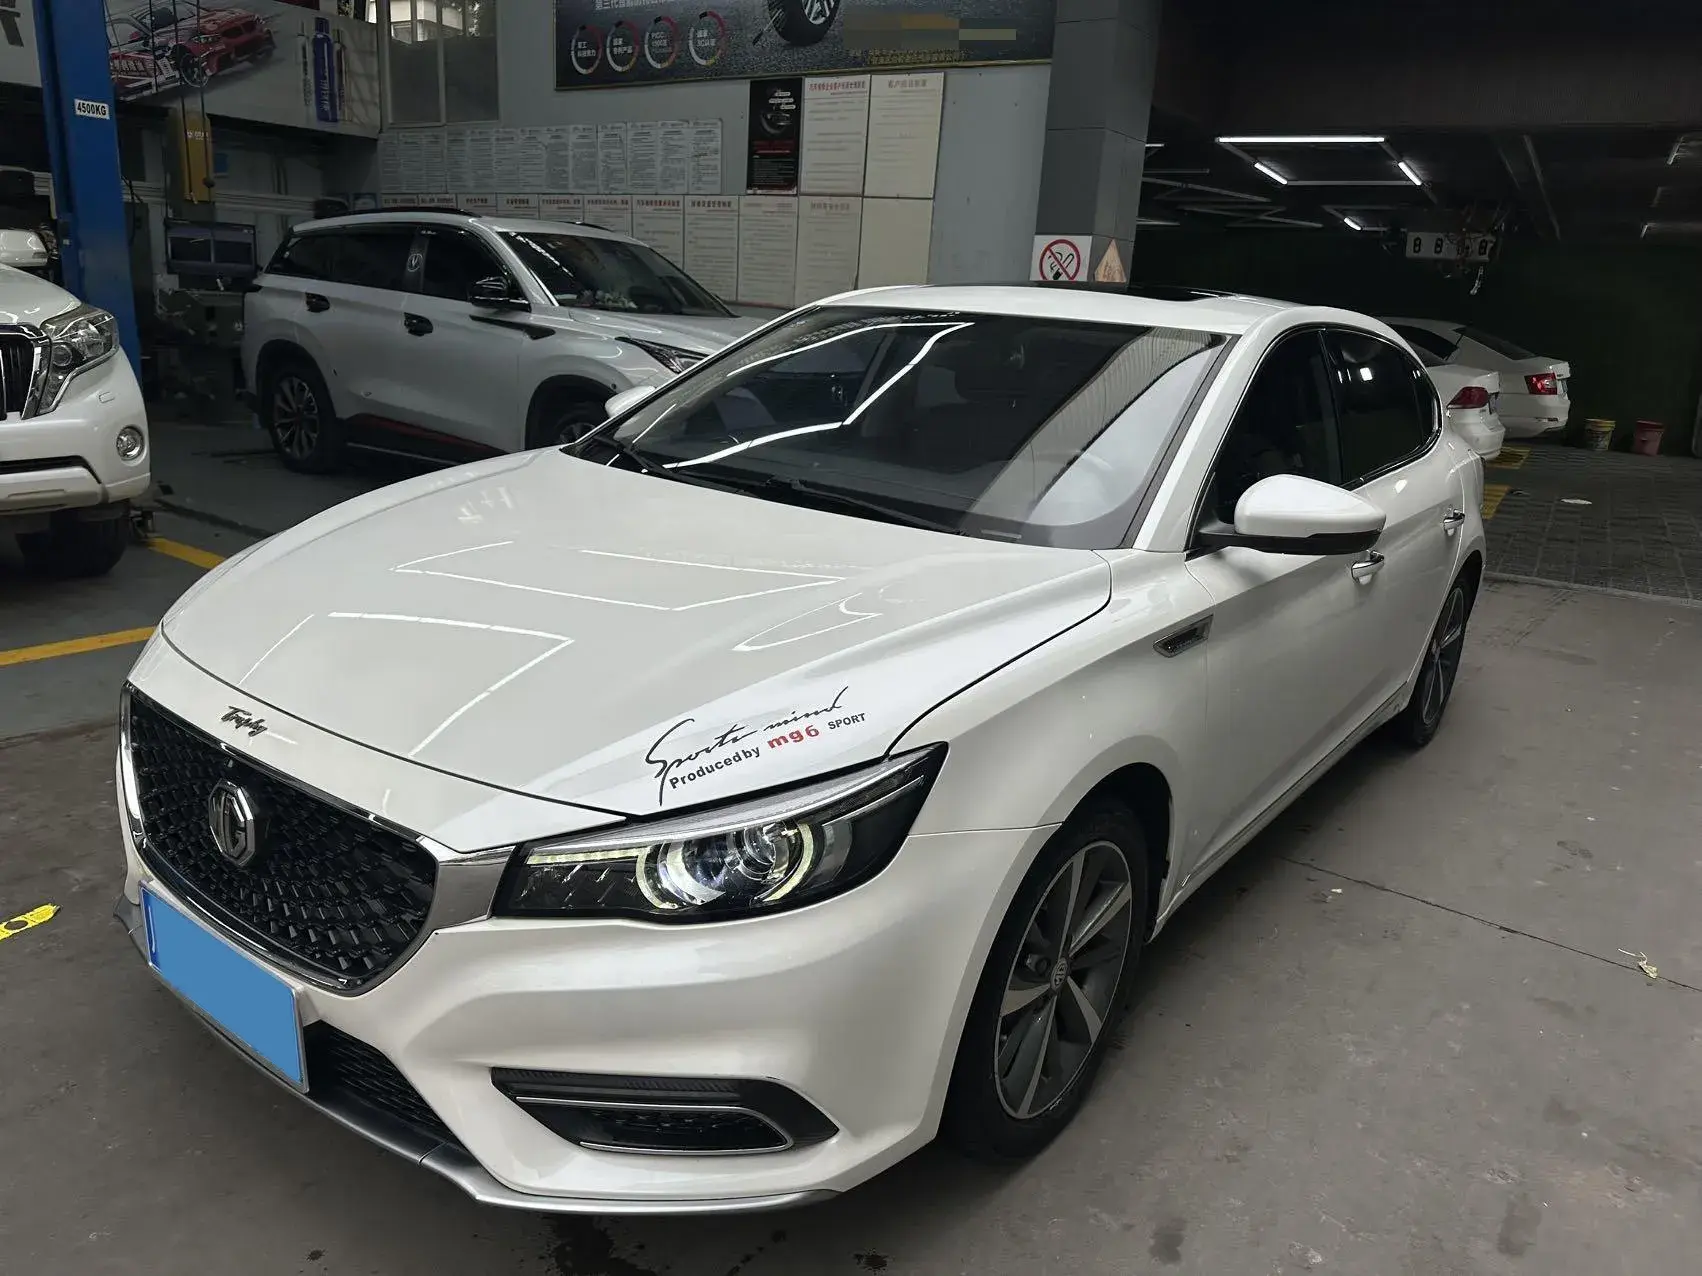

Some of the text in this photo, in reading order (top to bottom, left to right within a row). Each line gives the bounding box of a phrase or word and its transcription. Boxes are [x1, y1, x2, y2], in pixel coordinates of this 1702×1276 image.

[77, 102, 107, 116] 4500KG
[669, 753, 743, 790] Produced
[767, 724, 820, 749] mg6
[827, 712, 867, 731] SPORT
